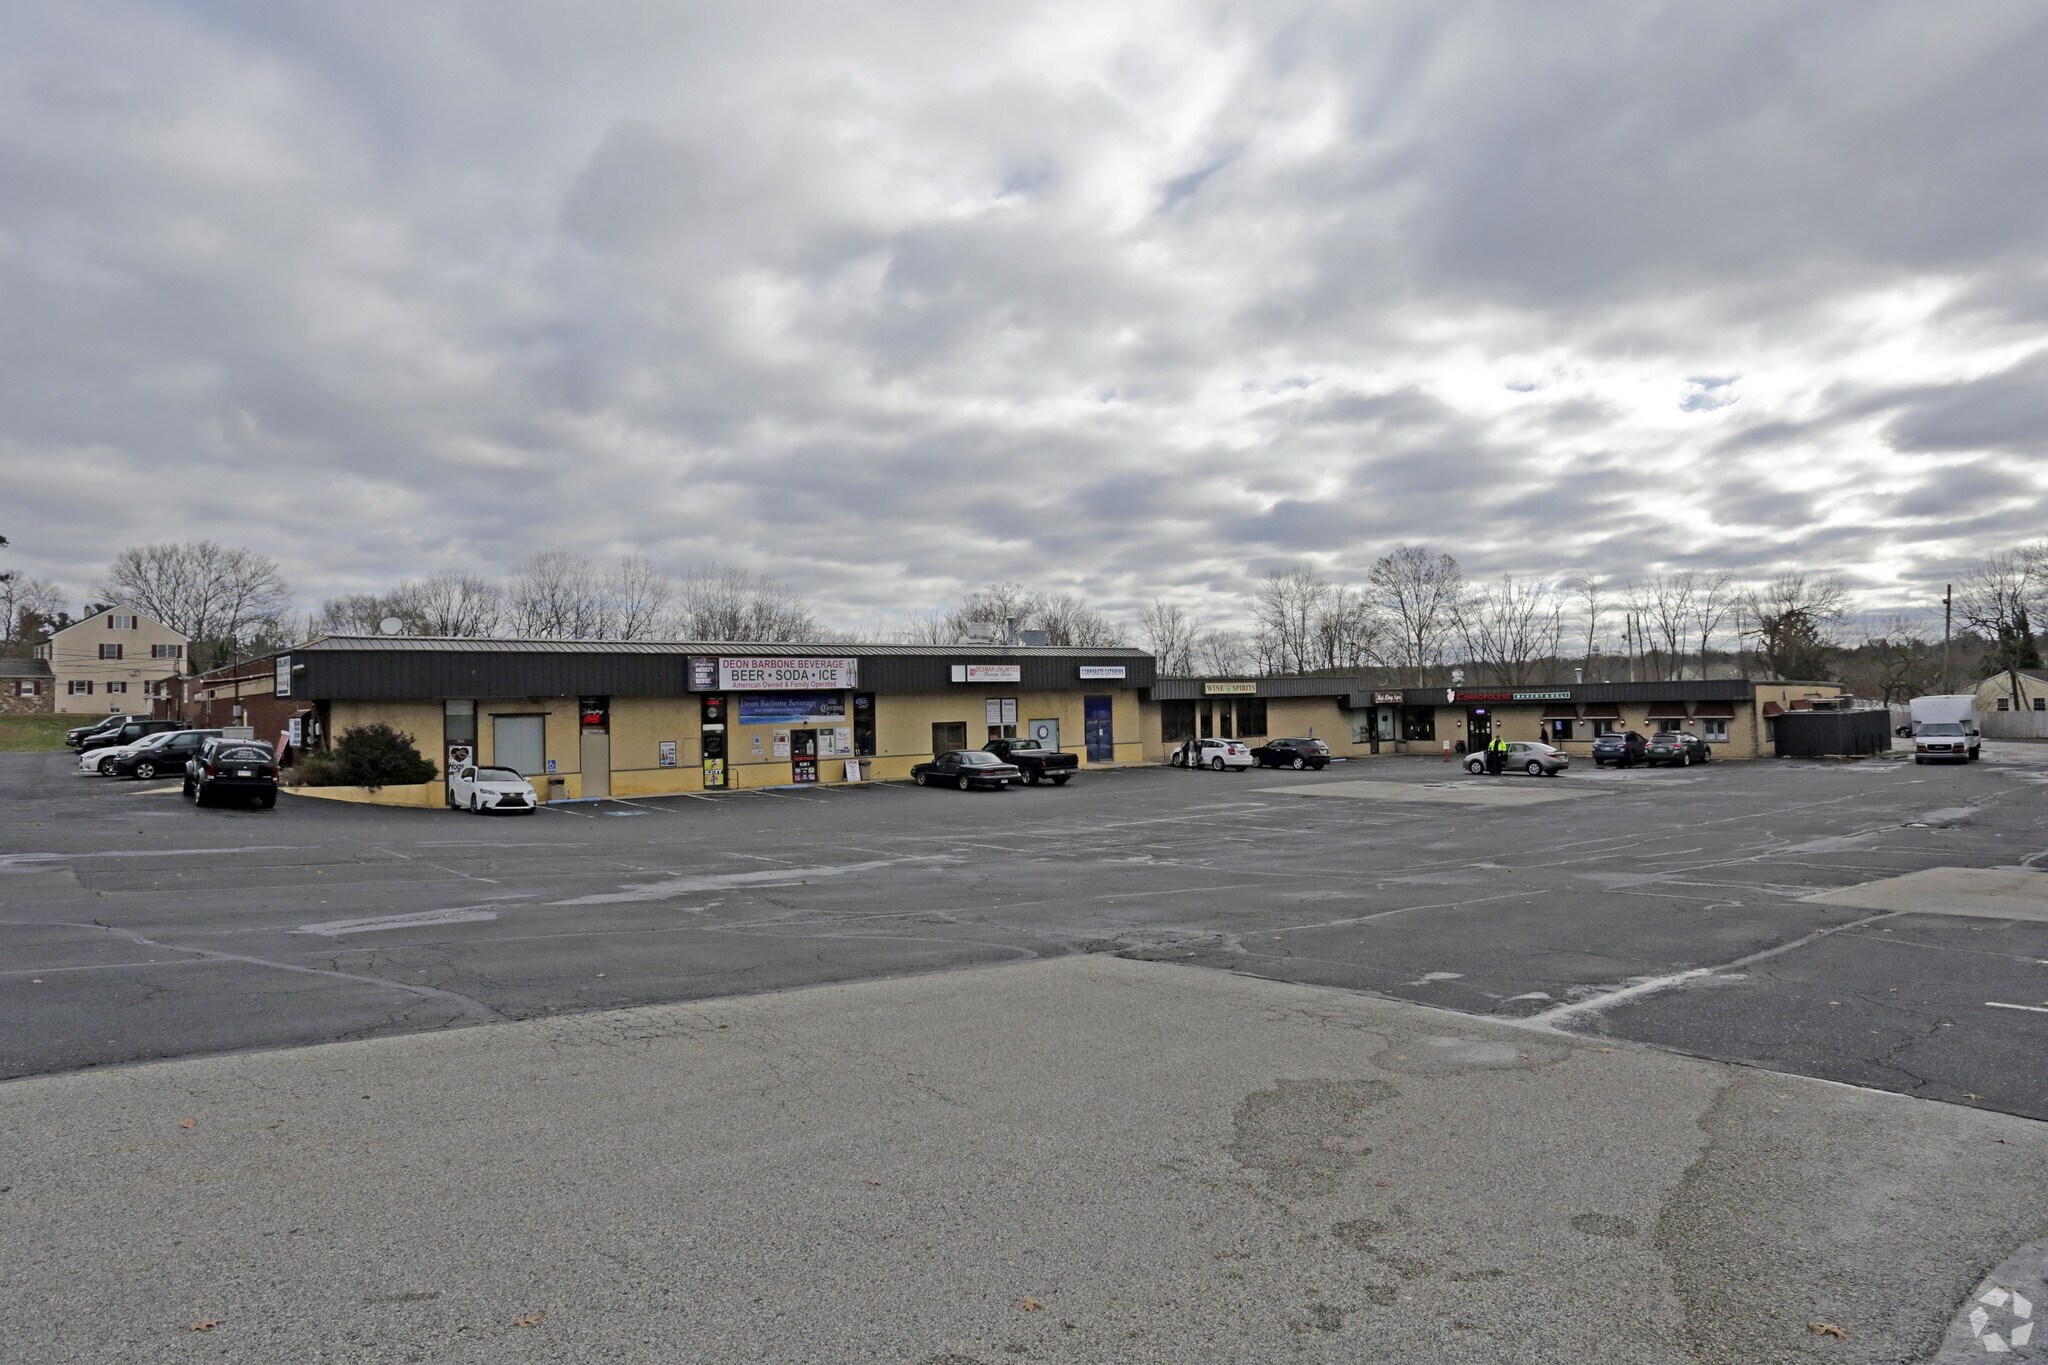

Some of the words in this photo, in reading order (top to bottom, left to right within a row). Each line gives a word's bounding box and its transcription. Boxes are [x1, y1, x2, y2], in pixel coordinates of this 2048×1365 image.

[723, 659, 749, 669] DEON
[752, 659, 796, 669] BARBONE
[799, 659, 844, 669] BEVERAGE
[731, 670, 765, 681] BEER
[775, 669, 809, 681] SODA
[818, 669, 837, 681] ICE
[1081, 668, 1104, 676] CORPORATE
[1105, 668, 1125, 676] CATERERS
[732, 681, 761, 689] American
[762, 681, 783, 689] Owned
[790, 681, 809, 689] Family
[811, 681, 837, 689] Operated
[1206, 684, 1225, 692] WINE
[1232, 684, 1256, 692] SPIRITS
[741, 700, 759, 708] Deon
[761, 699, 787, 707] Barbone
[789, 699, 817, 708] Beverage
[820, 704, 844, 713] Corona
